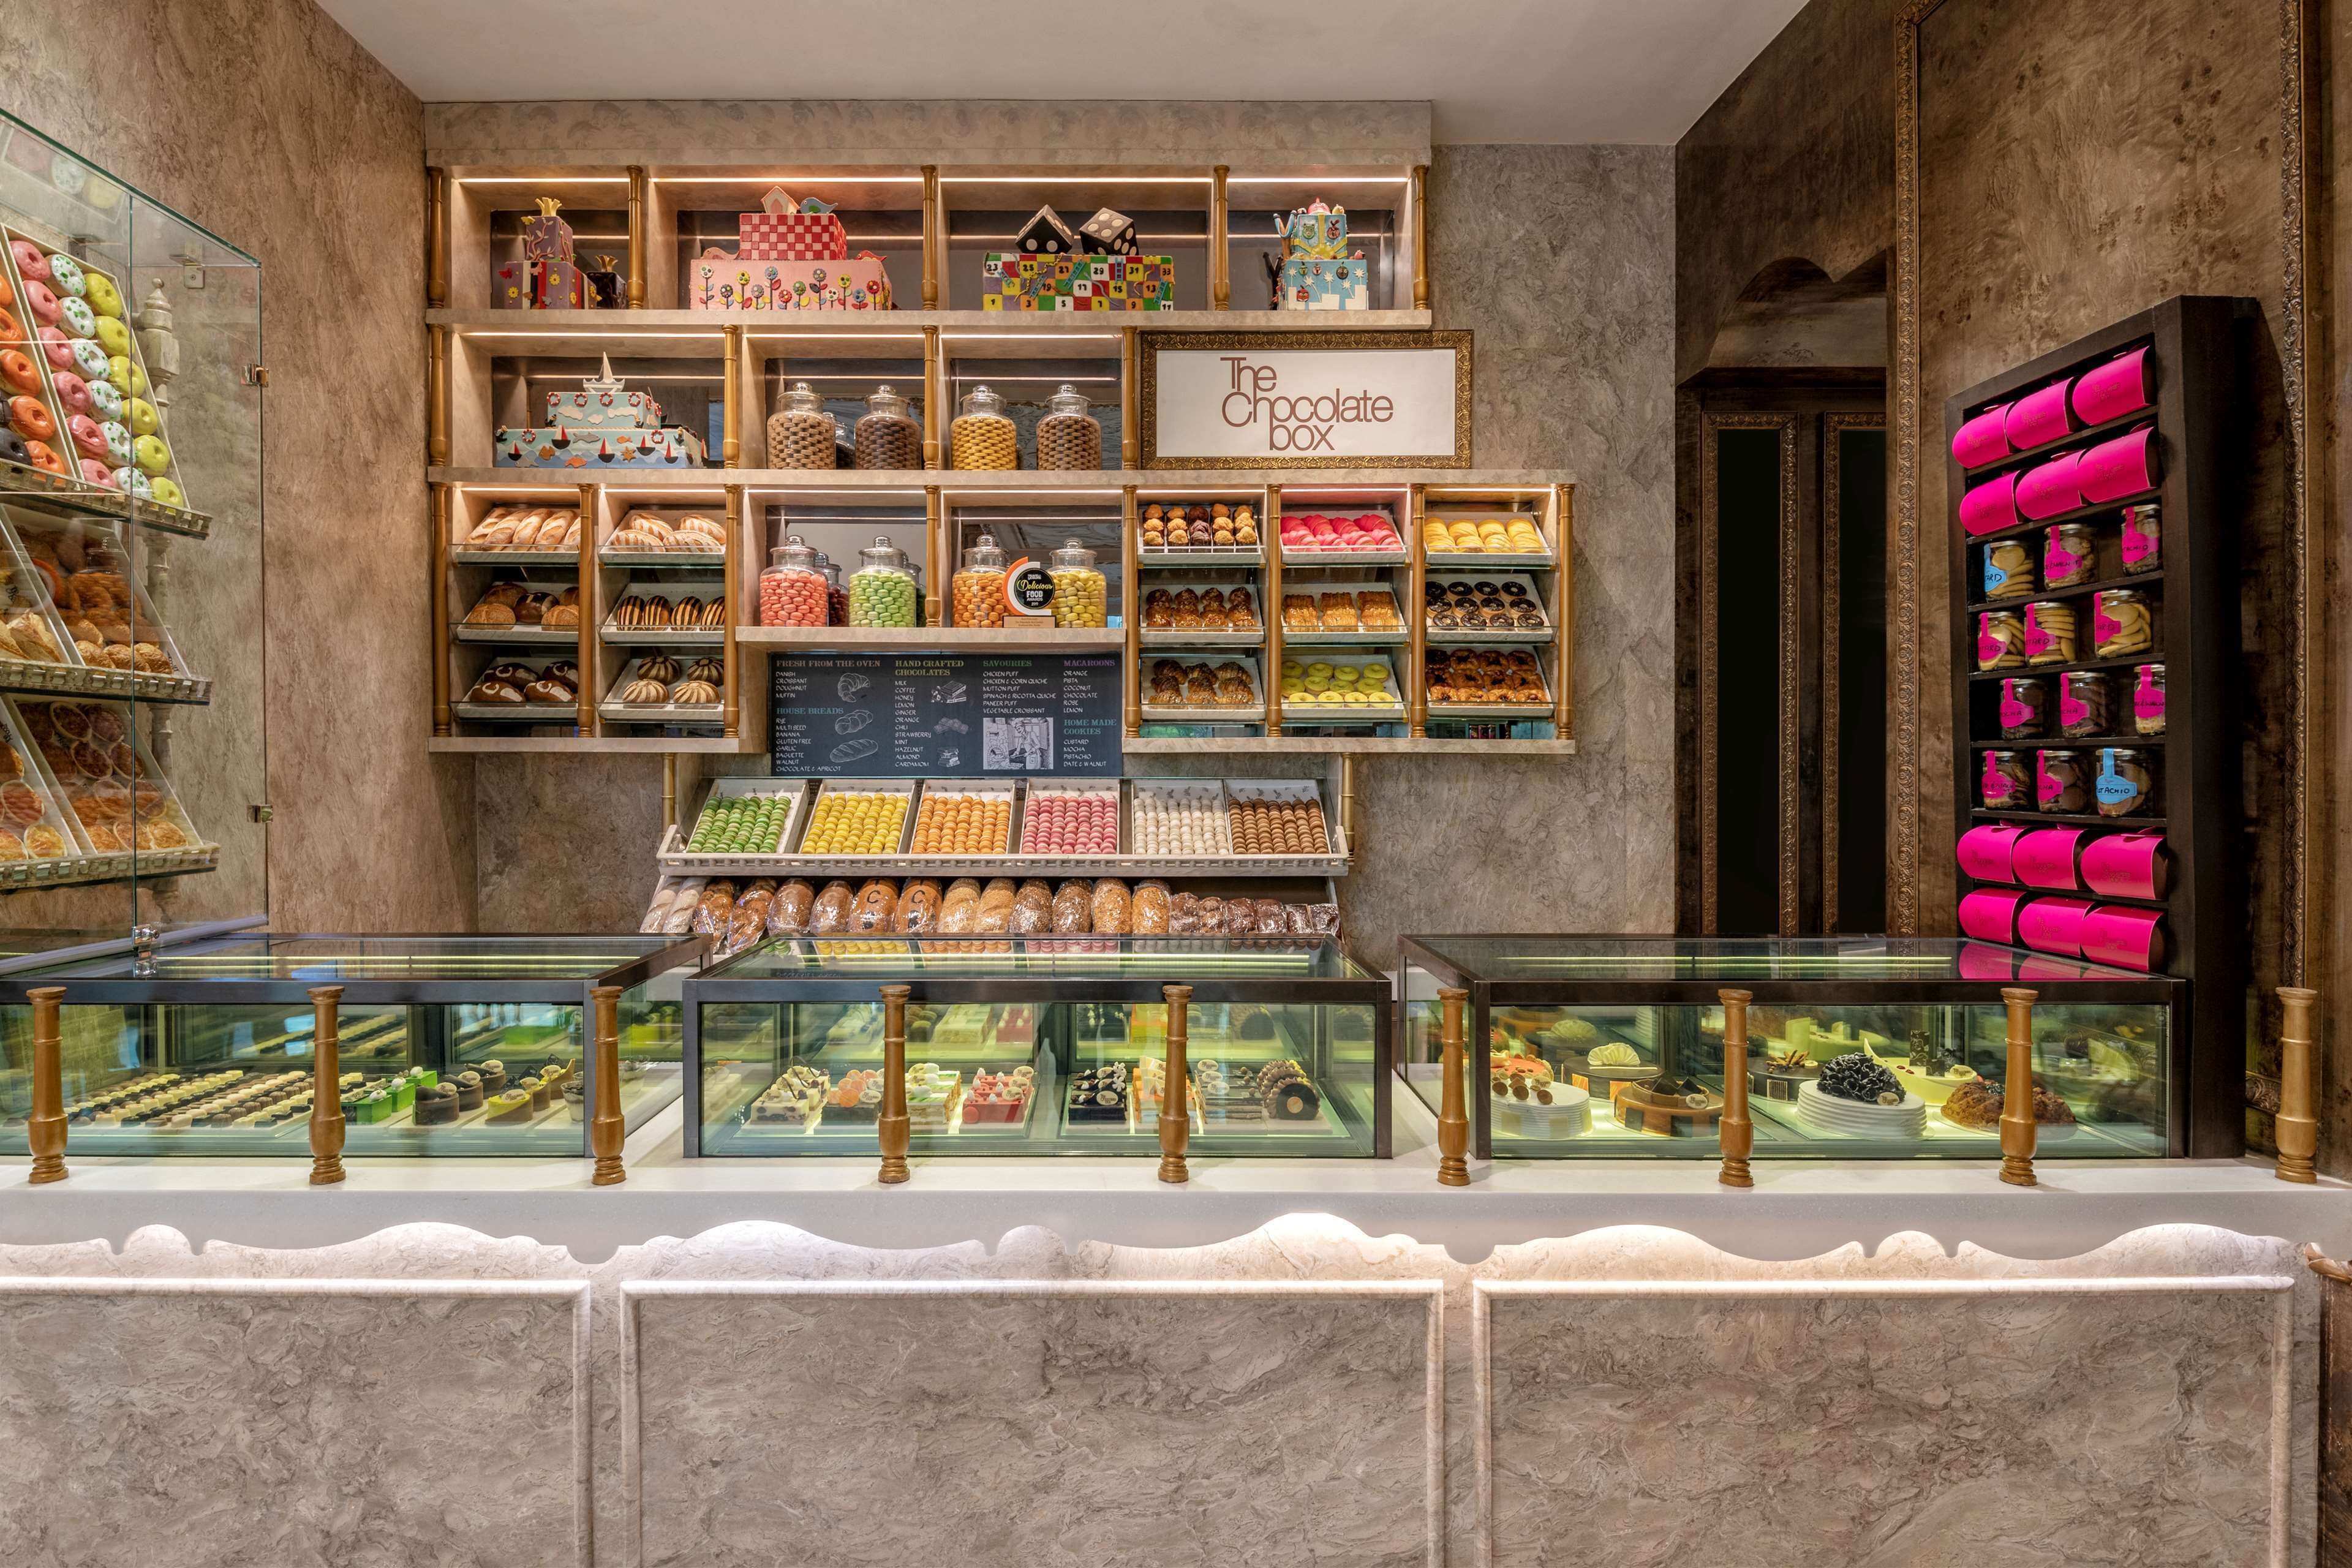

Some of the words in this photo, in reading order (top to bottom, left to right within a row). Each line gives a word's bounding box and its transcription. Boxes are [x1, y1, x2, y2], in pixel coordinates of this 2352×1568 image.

[986, 263, 998, 272] 23
[1022, 263, 1035, 272] 25
[1093, 264, 1104, 274] 29
[1128, 264, 1139, 274] 31
[1162, 264, 1171, 275] 33
[1077, 280, 1088, 291] 17
[1113, 281, 1123, 293] 15
[1146, 282, 1156, 293] 13
[1220, 356, 1277, 392] The
[1221, 388, 1393, 428] Chocolate
[1269, 424, 1335, 451] box
[1017, 579, 1054, 591] Delicious
